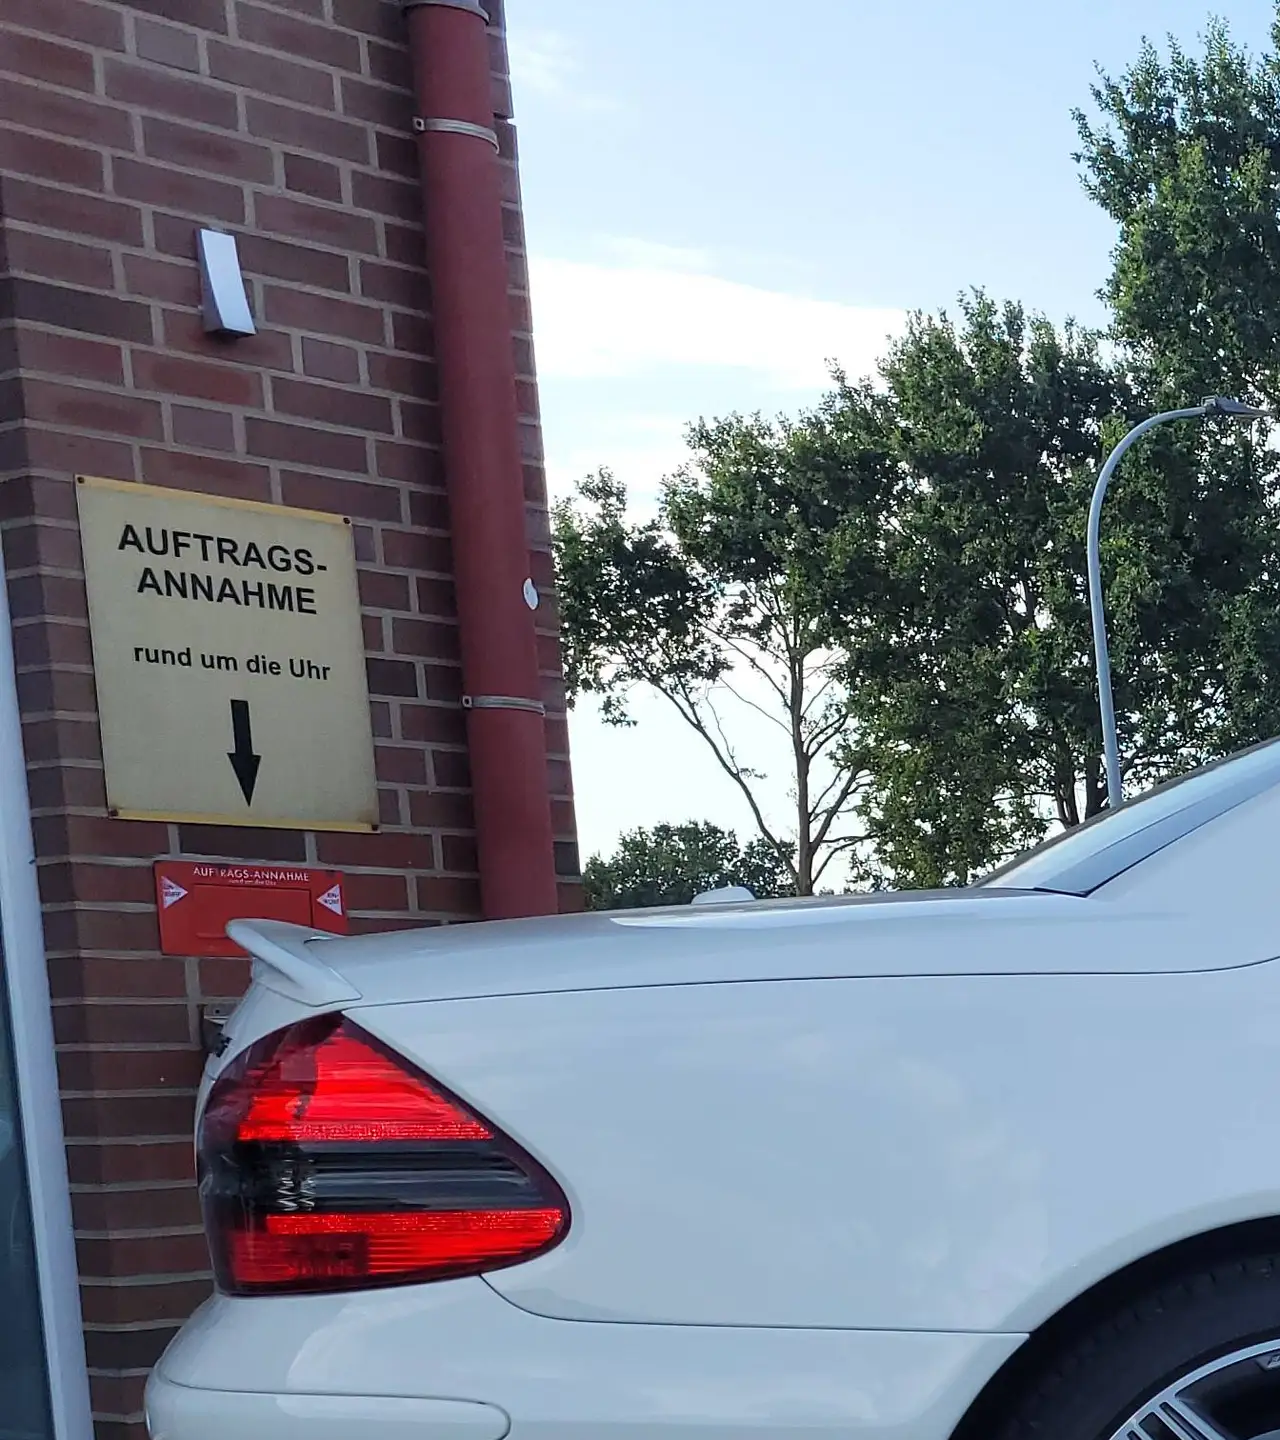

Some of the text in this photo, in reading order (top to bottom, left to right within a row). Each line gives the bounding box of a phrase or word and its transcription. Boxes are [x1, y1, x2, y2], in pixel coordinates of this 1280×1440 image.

[118, 524, 327, 575] AUFTRAGS-
[137, 567, 317, 615] ANNAHME
[133, 647, 331, 681] rund um die Uhr
[193, 867, 309, 882] AUFRAGS-ANNAHME
